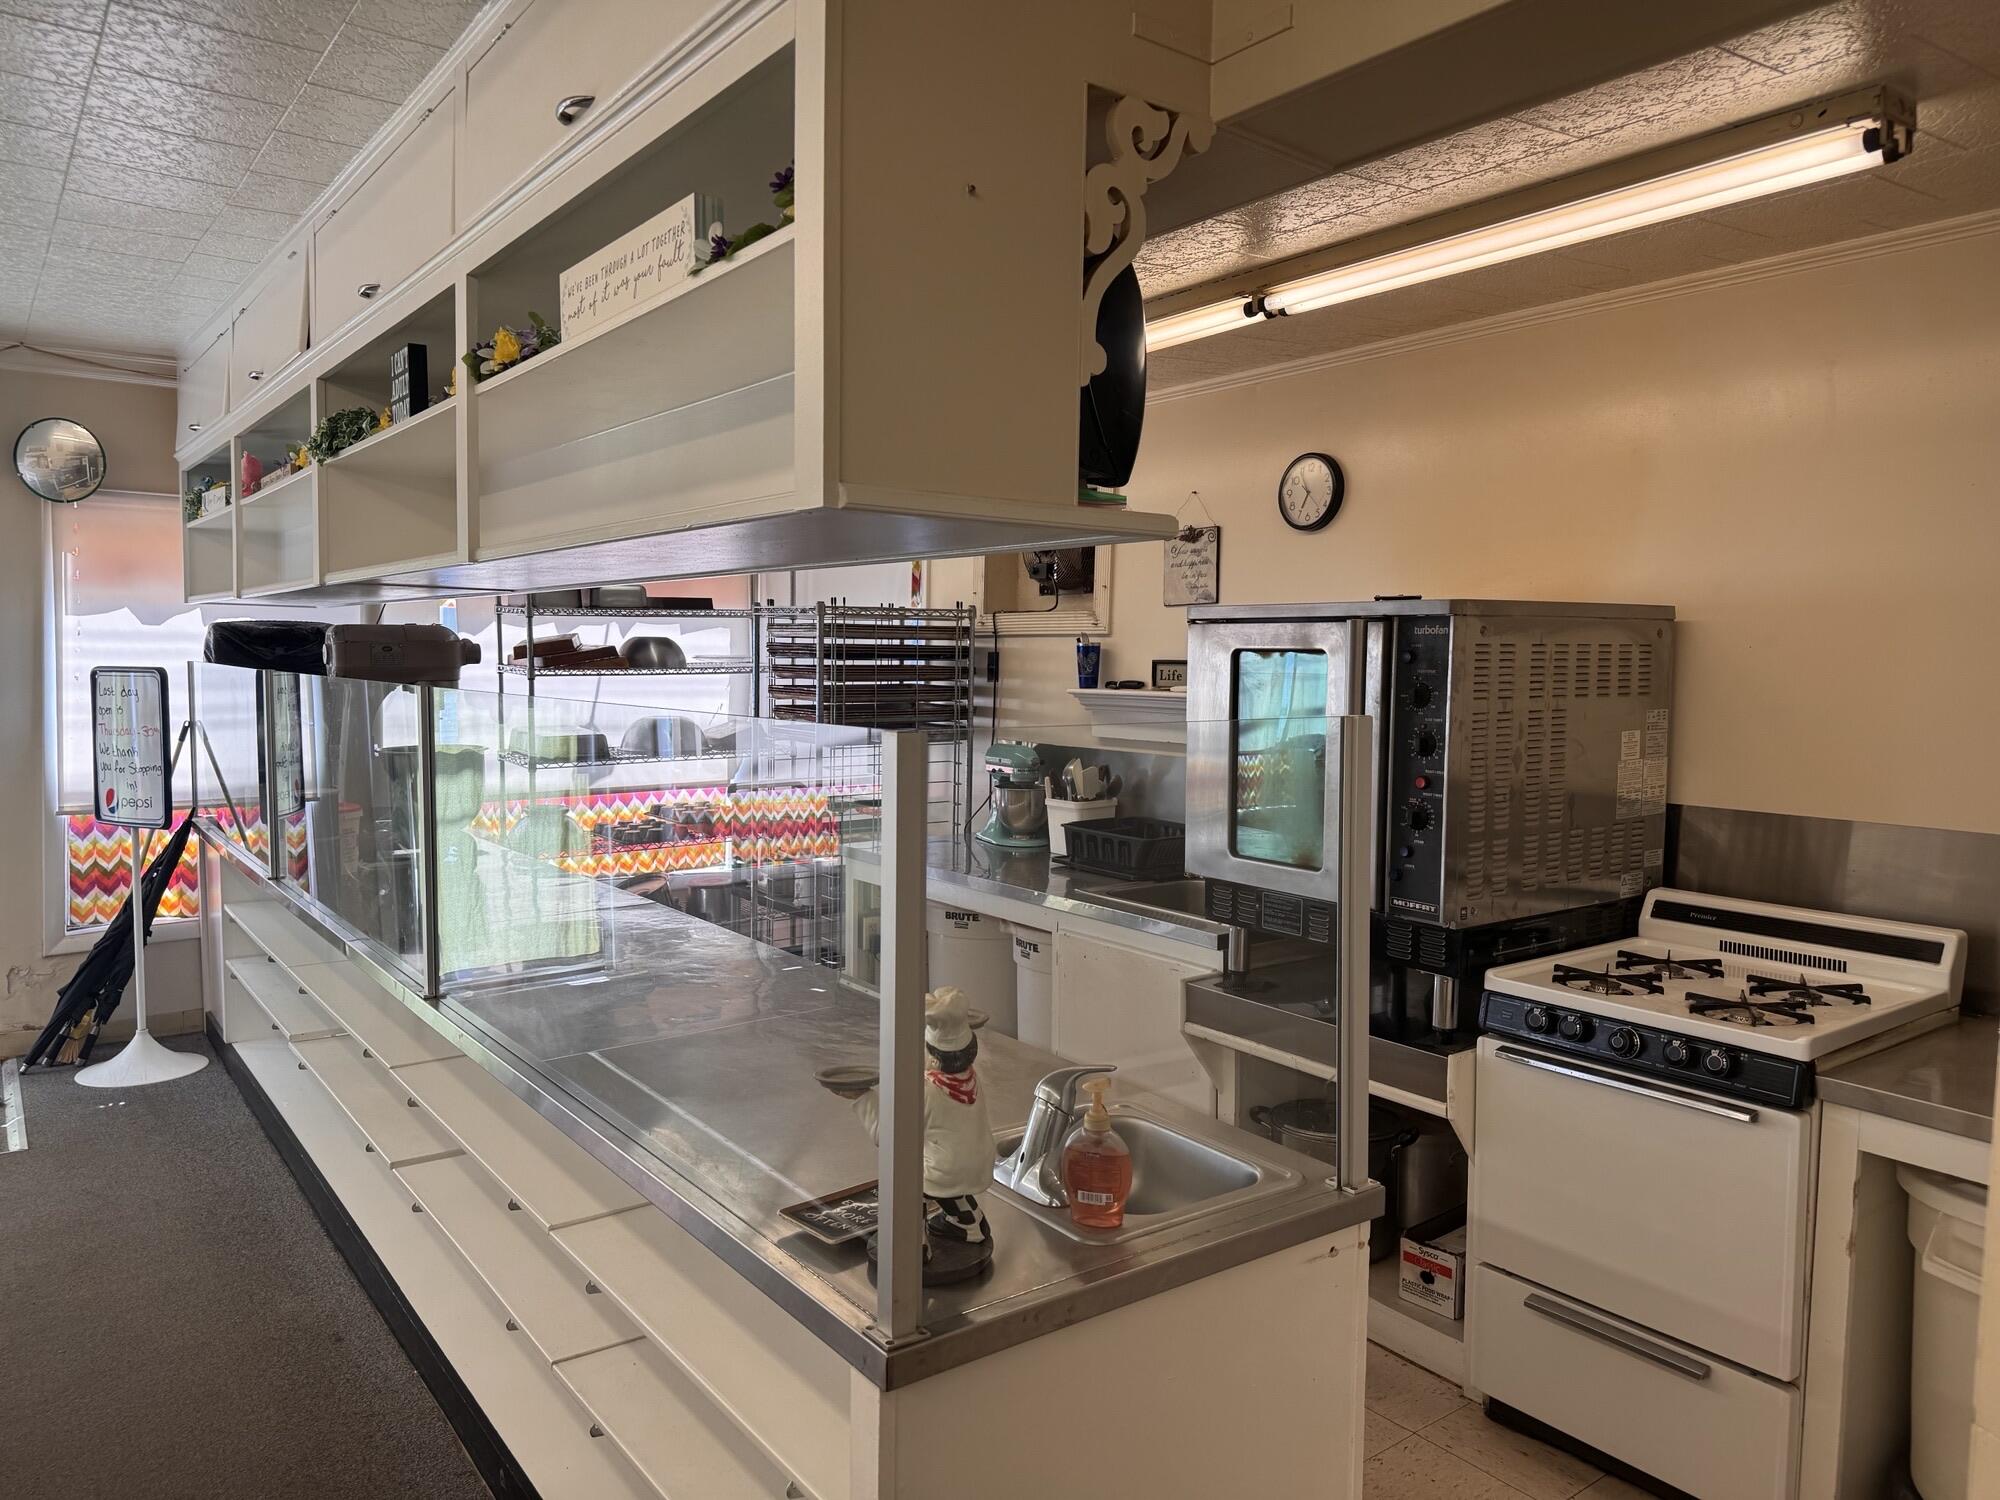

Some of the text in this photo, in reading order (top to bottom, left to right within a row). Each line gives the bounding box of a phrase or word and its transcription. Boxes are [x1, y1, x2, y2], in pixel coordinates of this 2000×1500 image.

[567, 279, 583, 298] WE'VE
[585, 273, 598, 291] BEEN
[601, 255, 628, 280] THROUGH
[637, 240, 650, 259] LOT
[651, 220, 686, 252] TOGETHER
[567, 241, 685, 321] most of it was your fault
[1291, 476, 1300, 485] 10
[1286, 489, 1293, 498] 9
[1289, 501, 1296, 511] 8
[1304, 512, 1311, 521] 6
[1414, 625, 1449, 635] turbofan
[1160, 669, 1183, 681] Life
[98, 683, 139, 702] Last day
[99, 705, 124, 718] open is
[98, 723, 137, 738] Thusday
[99, 743, 139, 758] We thank
[100, 761, 112, 782] you
[114, 760, 126, 774] for
[121, 797, 153, 811] pepsi
[1393, 899, 1436, 913] MOFFAT
[945, 911, 980, 922] BRUTE
[1689, 911, 1717, 921] Premier
[1015, 937, 1040, 953] BRUTE
[1418, 1246, 1439, 1261] Sysco
